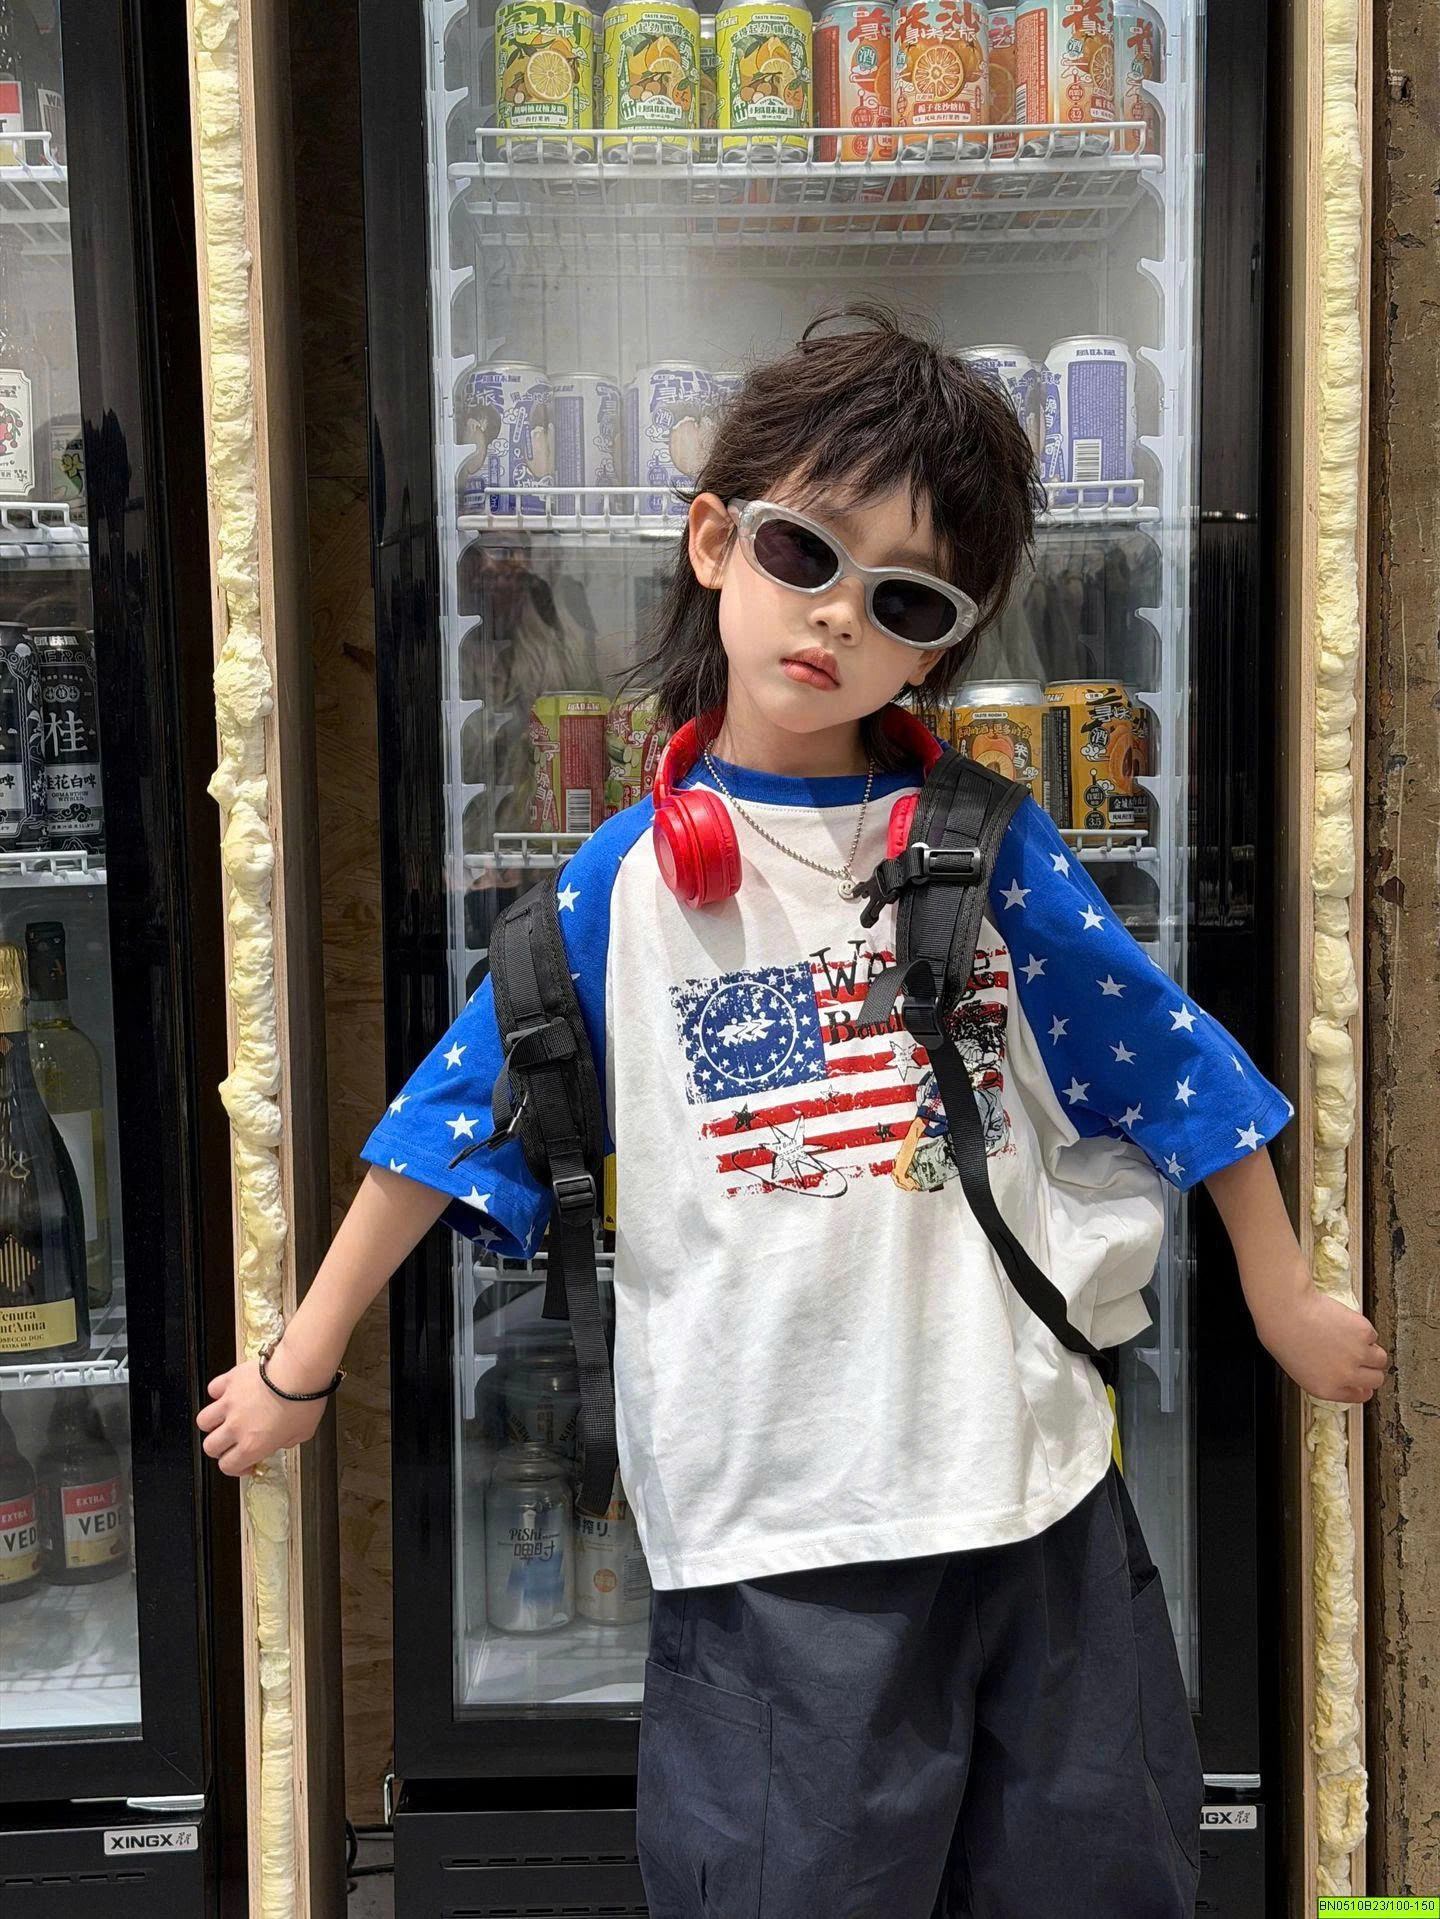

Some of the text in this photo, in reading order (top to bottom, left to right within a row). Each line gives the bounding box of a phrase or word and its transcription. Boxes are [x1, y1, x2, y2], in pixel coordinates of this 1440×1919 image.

[905, 26, 977, 44] 寻味之旅
[43, 709, 88, 757] 桂
[76, 1495, 105, 1507] EXTRA
[1, 1510, 28, 1523] EXTRA
[110, 1833, 174, 1850] XINGX
